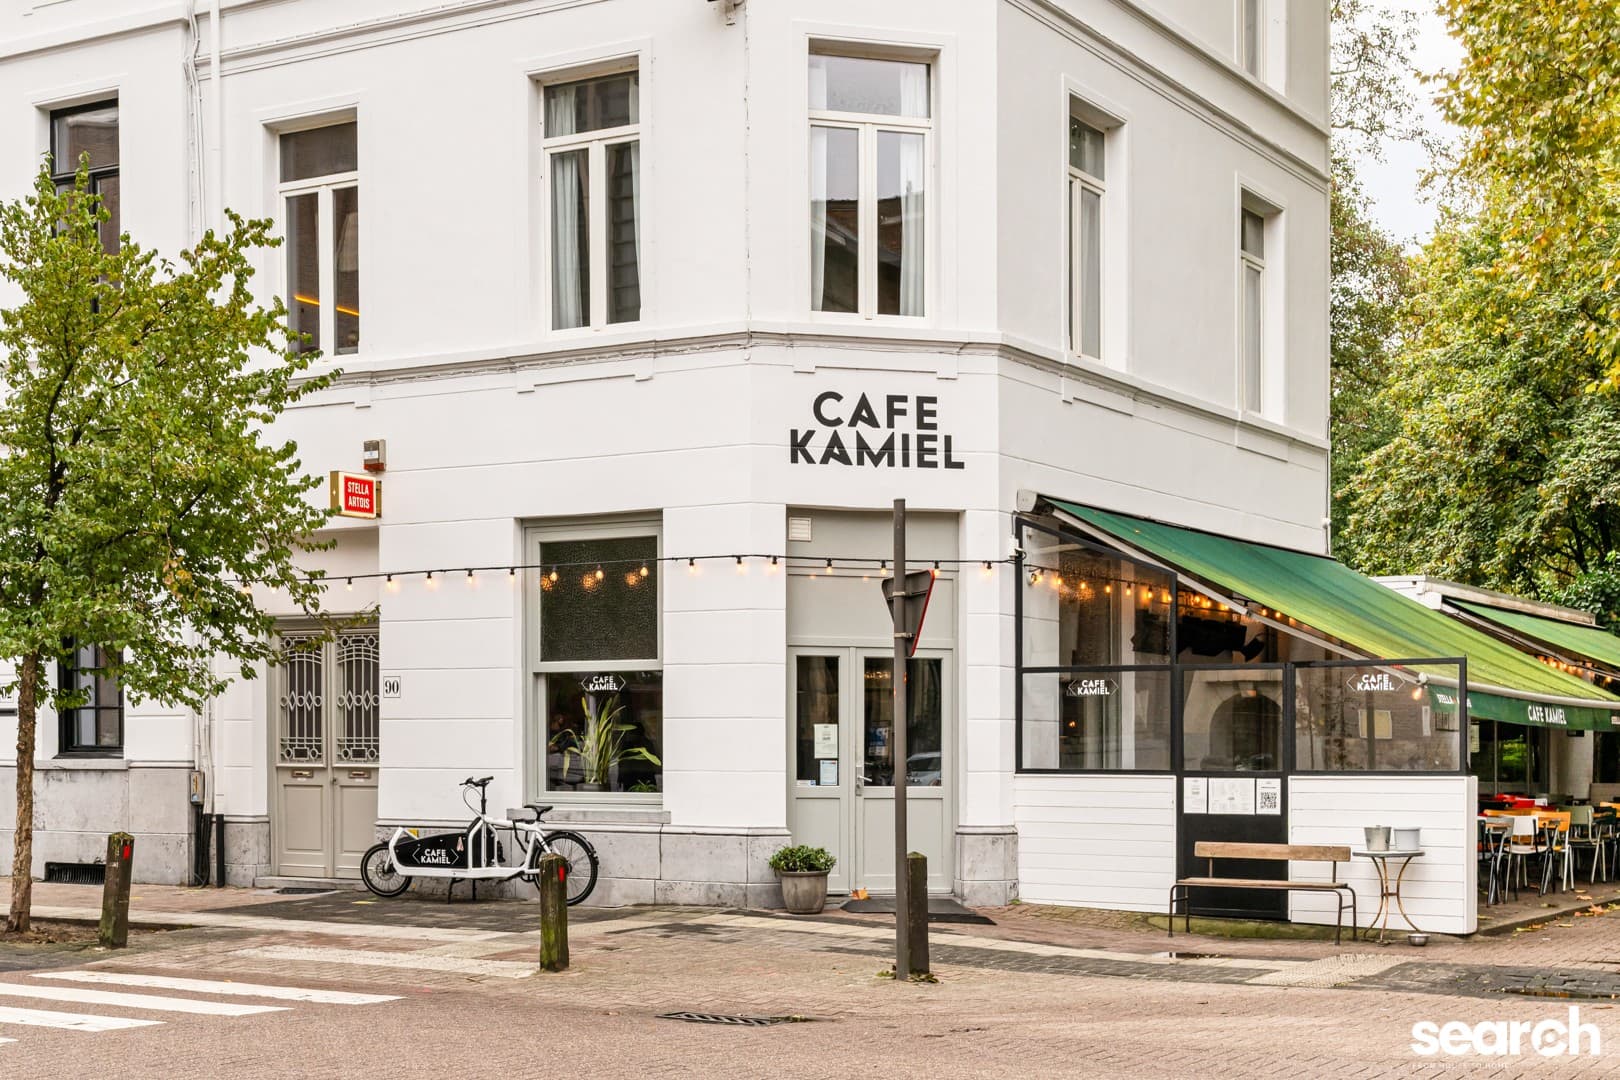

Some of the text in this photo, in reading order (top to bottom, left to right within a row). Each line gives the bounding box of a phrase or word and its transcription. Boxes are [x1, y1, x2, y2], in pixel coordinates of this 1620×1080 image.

[813, 391, 937, 431] CAFE
[790, 429, 965, 469] KAMIEL
[347, 481, 370, 495] STELLA
[348, 495, 370, 509] ARTOIS
[592, 676, 614, 684] CAFE
[1362, 674, 1390, 683] CAFE
[385, 680, 399, 694] 90
[589, 682, 618, 691] KAMIEL
[1081, 679, 1105, 688] CAFE
[1357, 681, 1395, 691] KAMIEL
[1077, 686, 1110, 695] KAMIEL
[1528, 705, 1567, 725] CAFE KAMIEL
[424, 848, 447, 857] CAFE
[420, 855, 451, 864] KAMIEL
